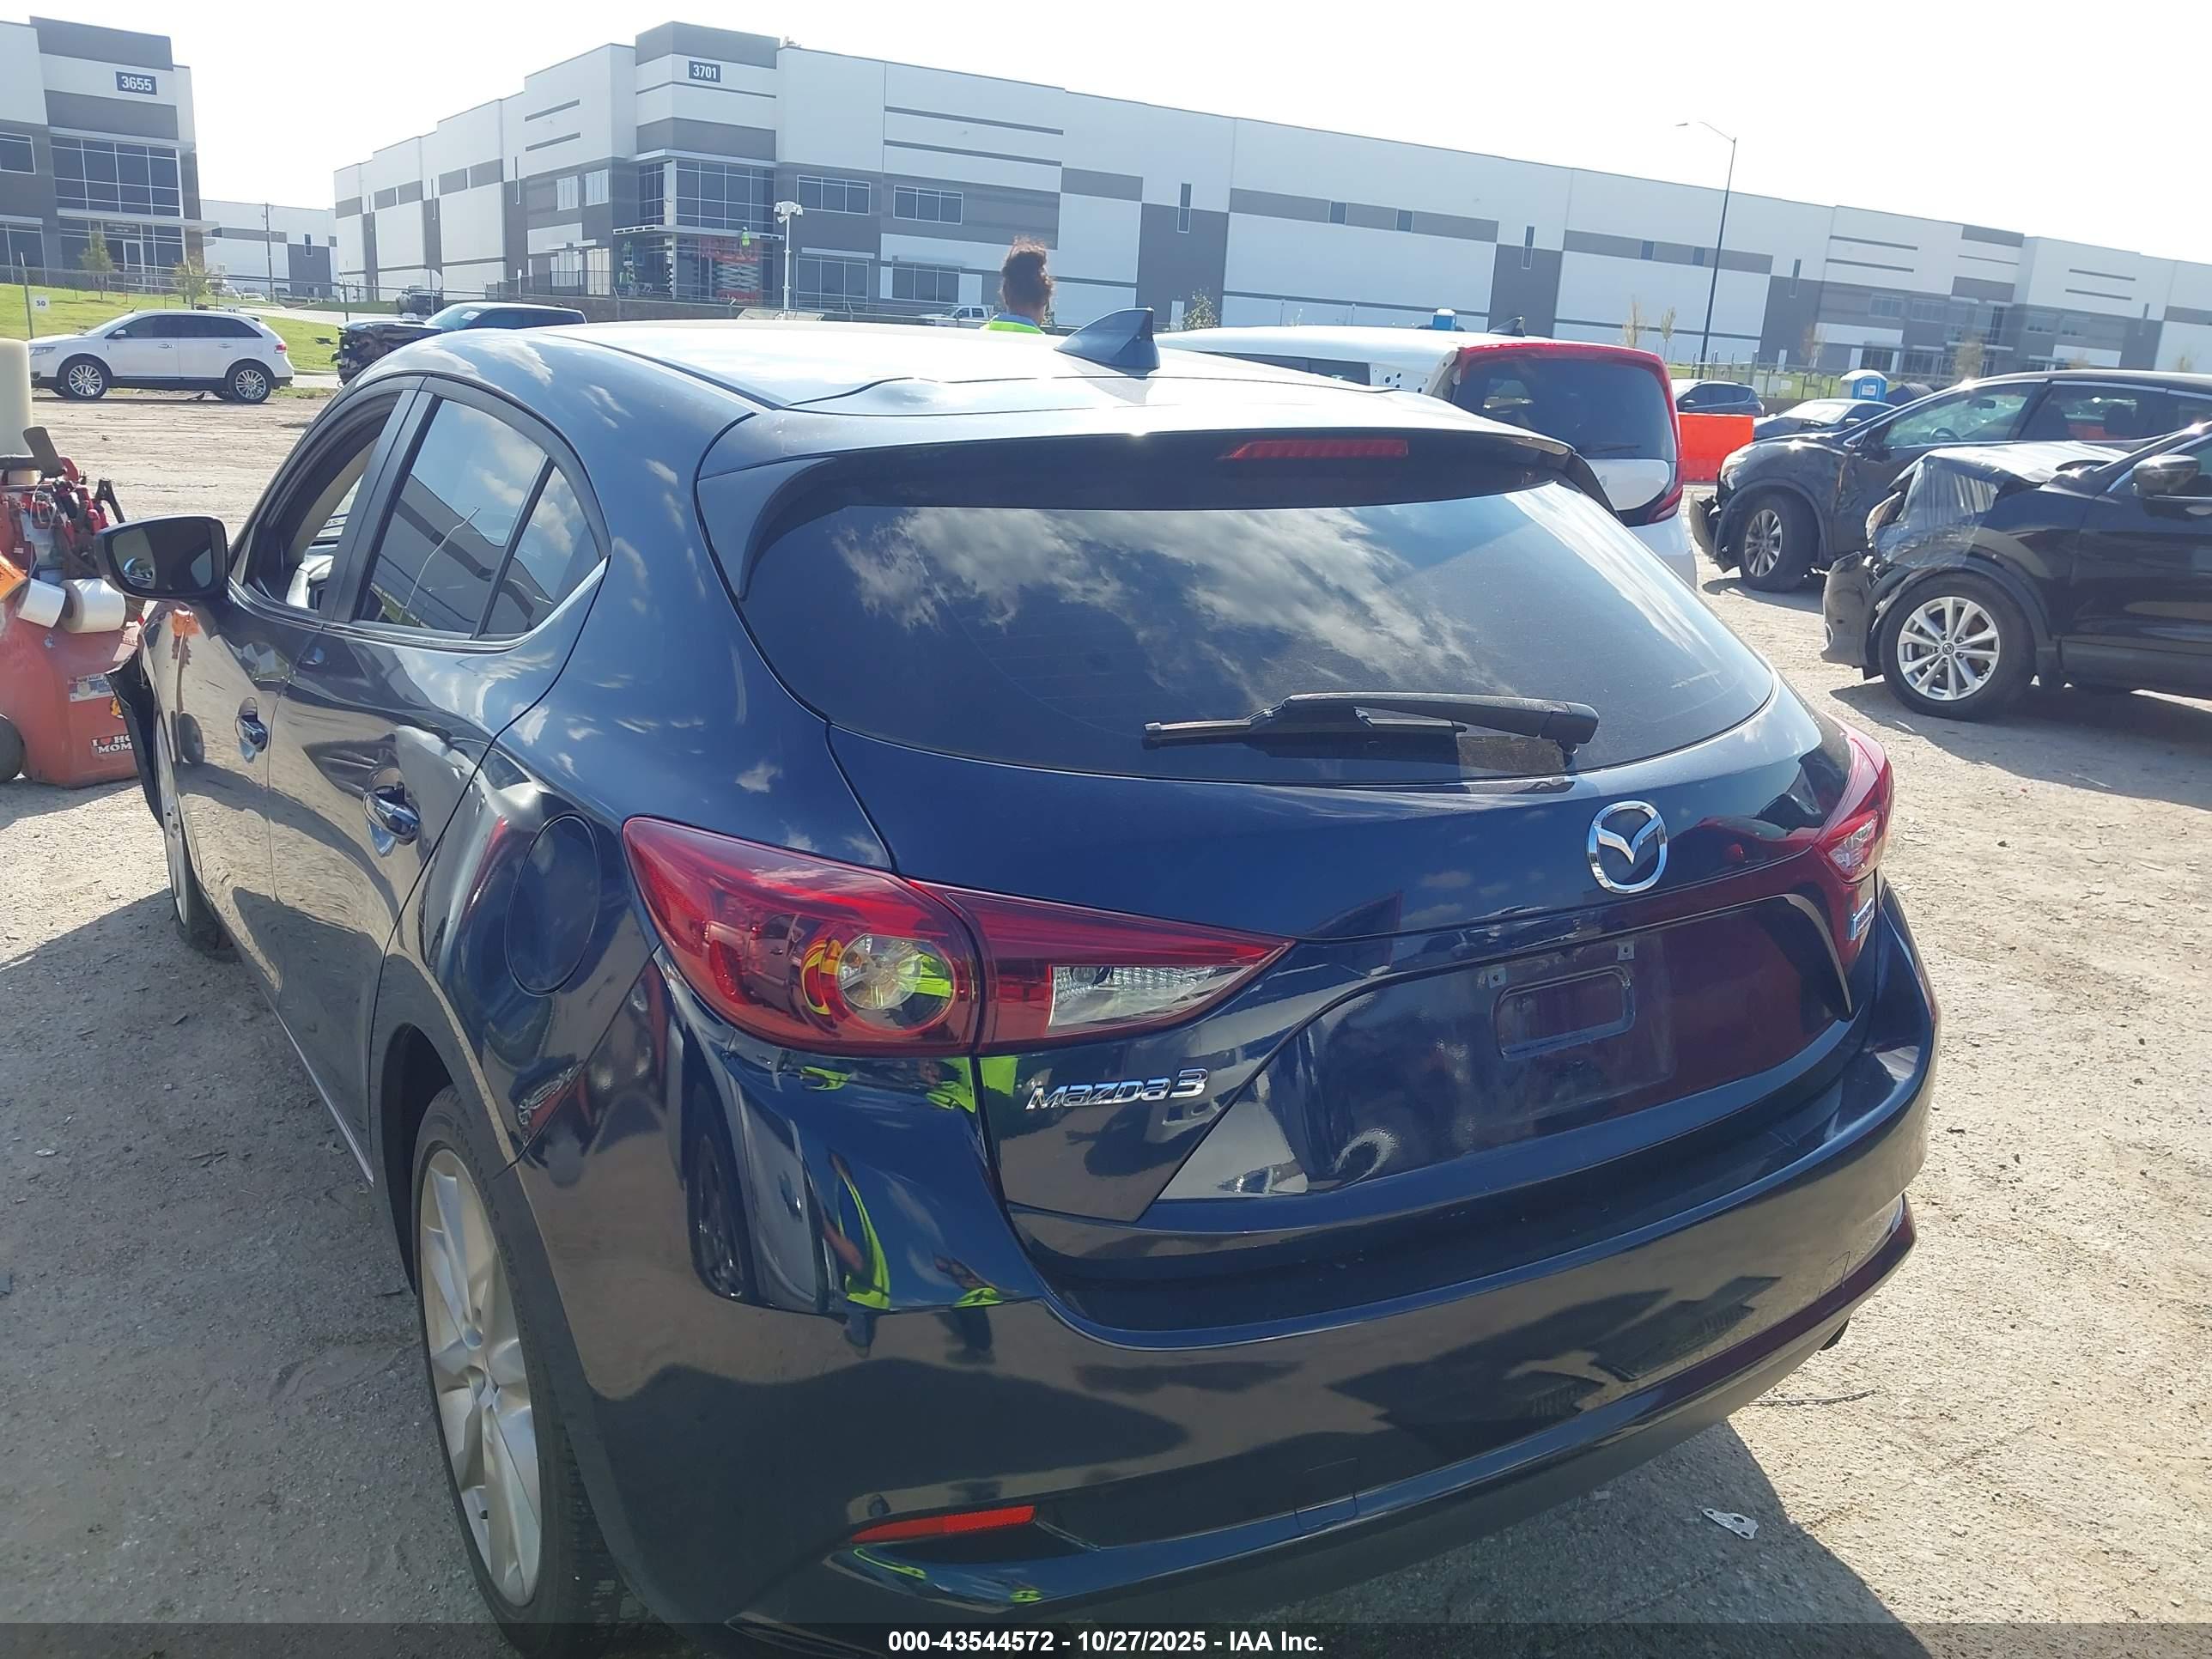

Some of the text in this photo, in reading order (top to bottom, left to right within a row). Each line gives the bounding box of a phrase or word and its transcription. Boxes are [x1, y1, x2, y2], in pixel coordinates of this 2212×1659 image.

[693, 64, 717, 79] 3701
[121, 76, 152, 91] 3655
[92, 738, 99, 747] I
